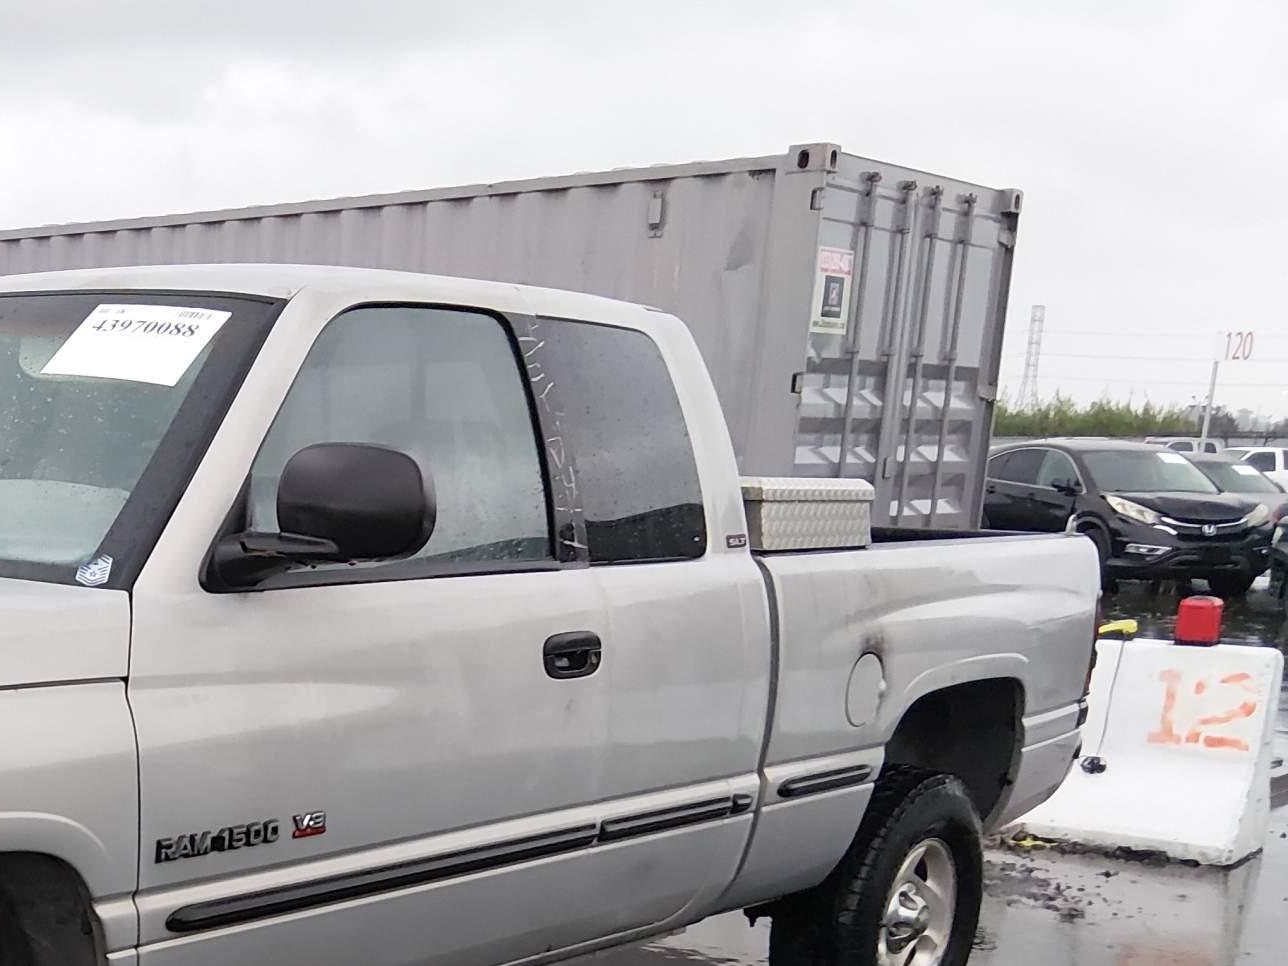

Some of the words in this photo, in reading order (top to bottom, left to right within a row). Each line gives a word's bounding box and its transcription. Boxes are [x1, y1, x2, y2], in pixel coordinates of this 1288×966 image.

[92, 319, 200, 338] 43970088
[1224, 331, 1255, 361] 120
[1146, 669, 1257, 752] 12
[155, 830, 214, 864] RAM
[216, 818, 281, 852] 1500
